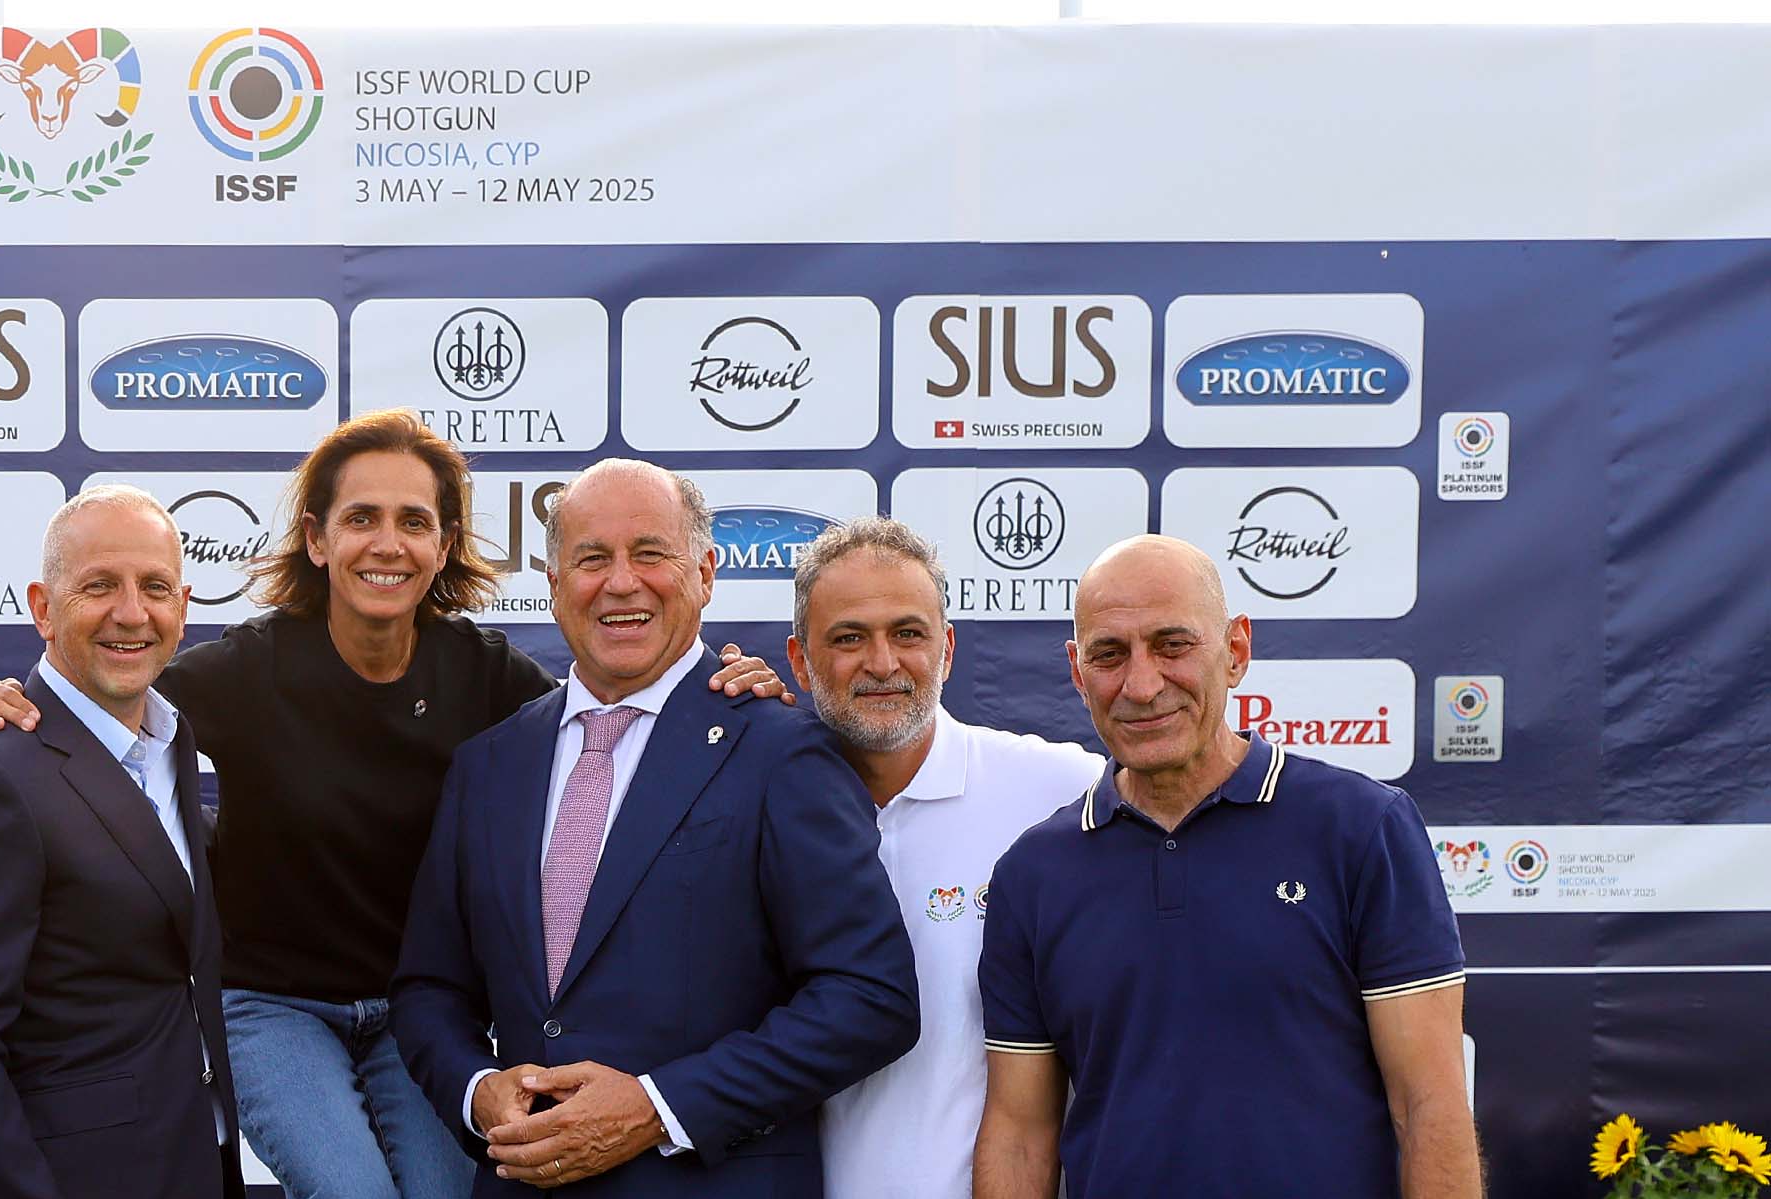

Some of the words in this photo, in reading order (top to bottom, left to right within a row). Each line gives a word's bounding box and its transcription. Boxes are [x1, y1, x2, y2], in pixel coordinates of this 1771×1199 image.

[357, 71, 410, 95] ISSF
[420, 70, 525, 95] WORLD
[534, 70, 591, 95] CUP
[356, 107, 496, 131] SHOTGUN
[357, 143, 478, 171] NICOSIA,
[486, 142, 540, 167] CYP
[215, 175, 297, 202] ISSF
[356, 179, 370, 203] 3
[380, 178, 444, 203] MAY
[477, 178, 508, 203] 12
[516, 178, 581, 203] MAY
[589, 178, 655, 202] 2025
[927, 306, 1117, 398] SIUS
[114, 371, 304, 399] PROMATIC
[690, 356, 814, 394] Rottweil
[1199, 367, 1388, 395] PROMATIC
[420, 409, 566, 443] ERETTA
[972, 424, 1019, 437] SWISS
[1024, 424, 1103, 437] PRECISION
[1441, 484, 1504, 493] SPONSORS
[1444, 474, 1503, 483] PLATINUM
[1227, 524, 1351, 561] Rottweil
[1232, 695, 1392, 745] Perazzi
[1441, 747, 1496, 756] SPONSOR
[1448, 737, 1489, 745] SILVER
[1559, 865, 1605, 874] SHOTGUN
